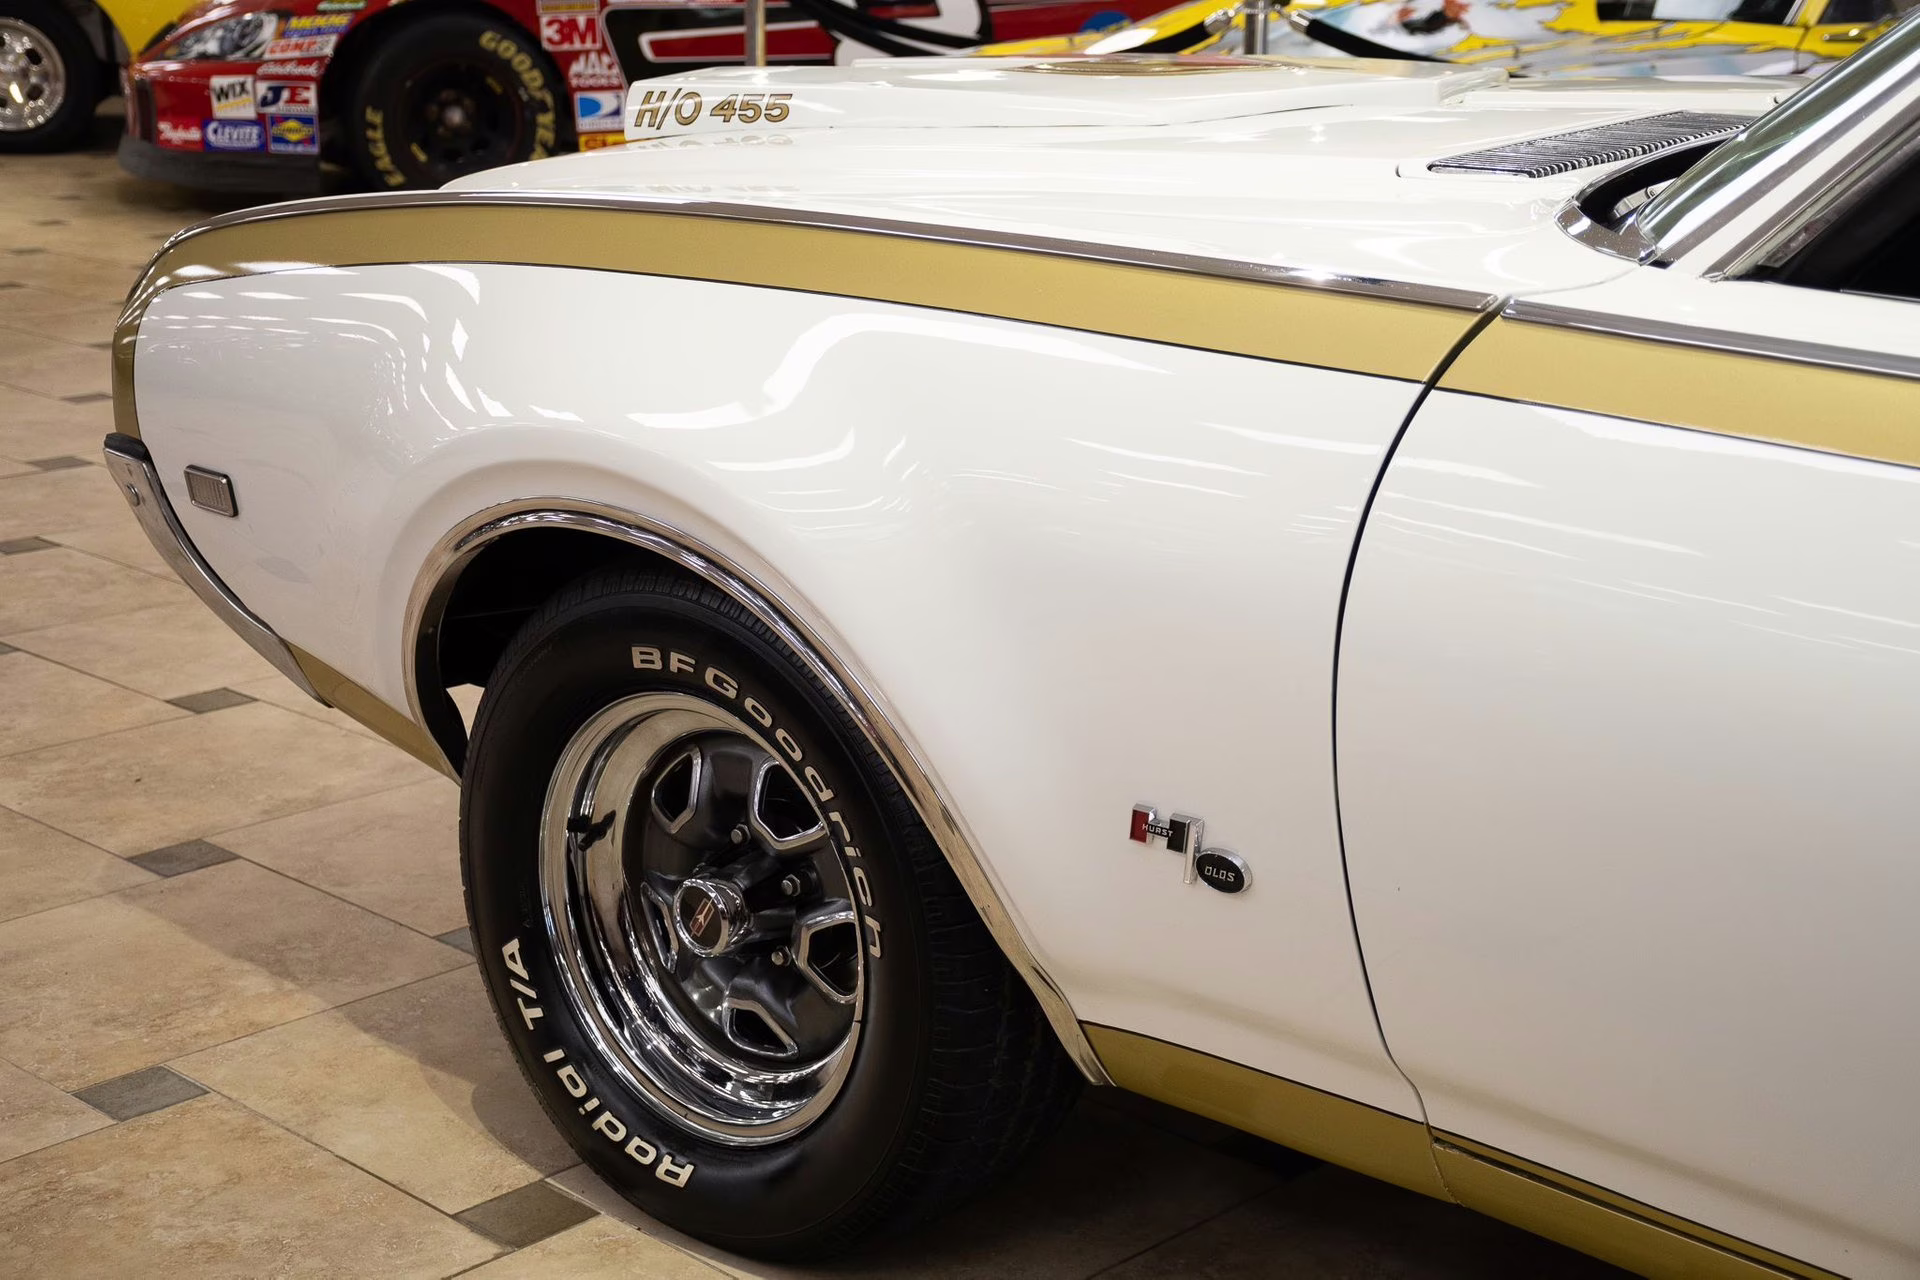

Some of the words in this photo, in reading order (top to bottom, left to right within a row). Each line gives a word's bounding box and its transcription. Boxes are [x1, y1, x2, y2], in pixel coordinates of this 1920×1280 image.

[286, 13, 353, 29] MOOG
[545, 18, 598, 46] 3M
[212, 81, 249, 102] WIX
[479, 30, 557, 162] GOODYEA
[634, 88, 703, 131] H/O
[709, 93, 794, 124] 455
[365, 105, 406, 187] EAGLE
[1142, 823, 1174, 838] HURST
[1204, 865, 1236, 882] OLDS
[502, 938, 545, 1031] T/A
[543, 1049, 695, 1188] Radial
